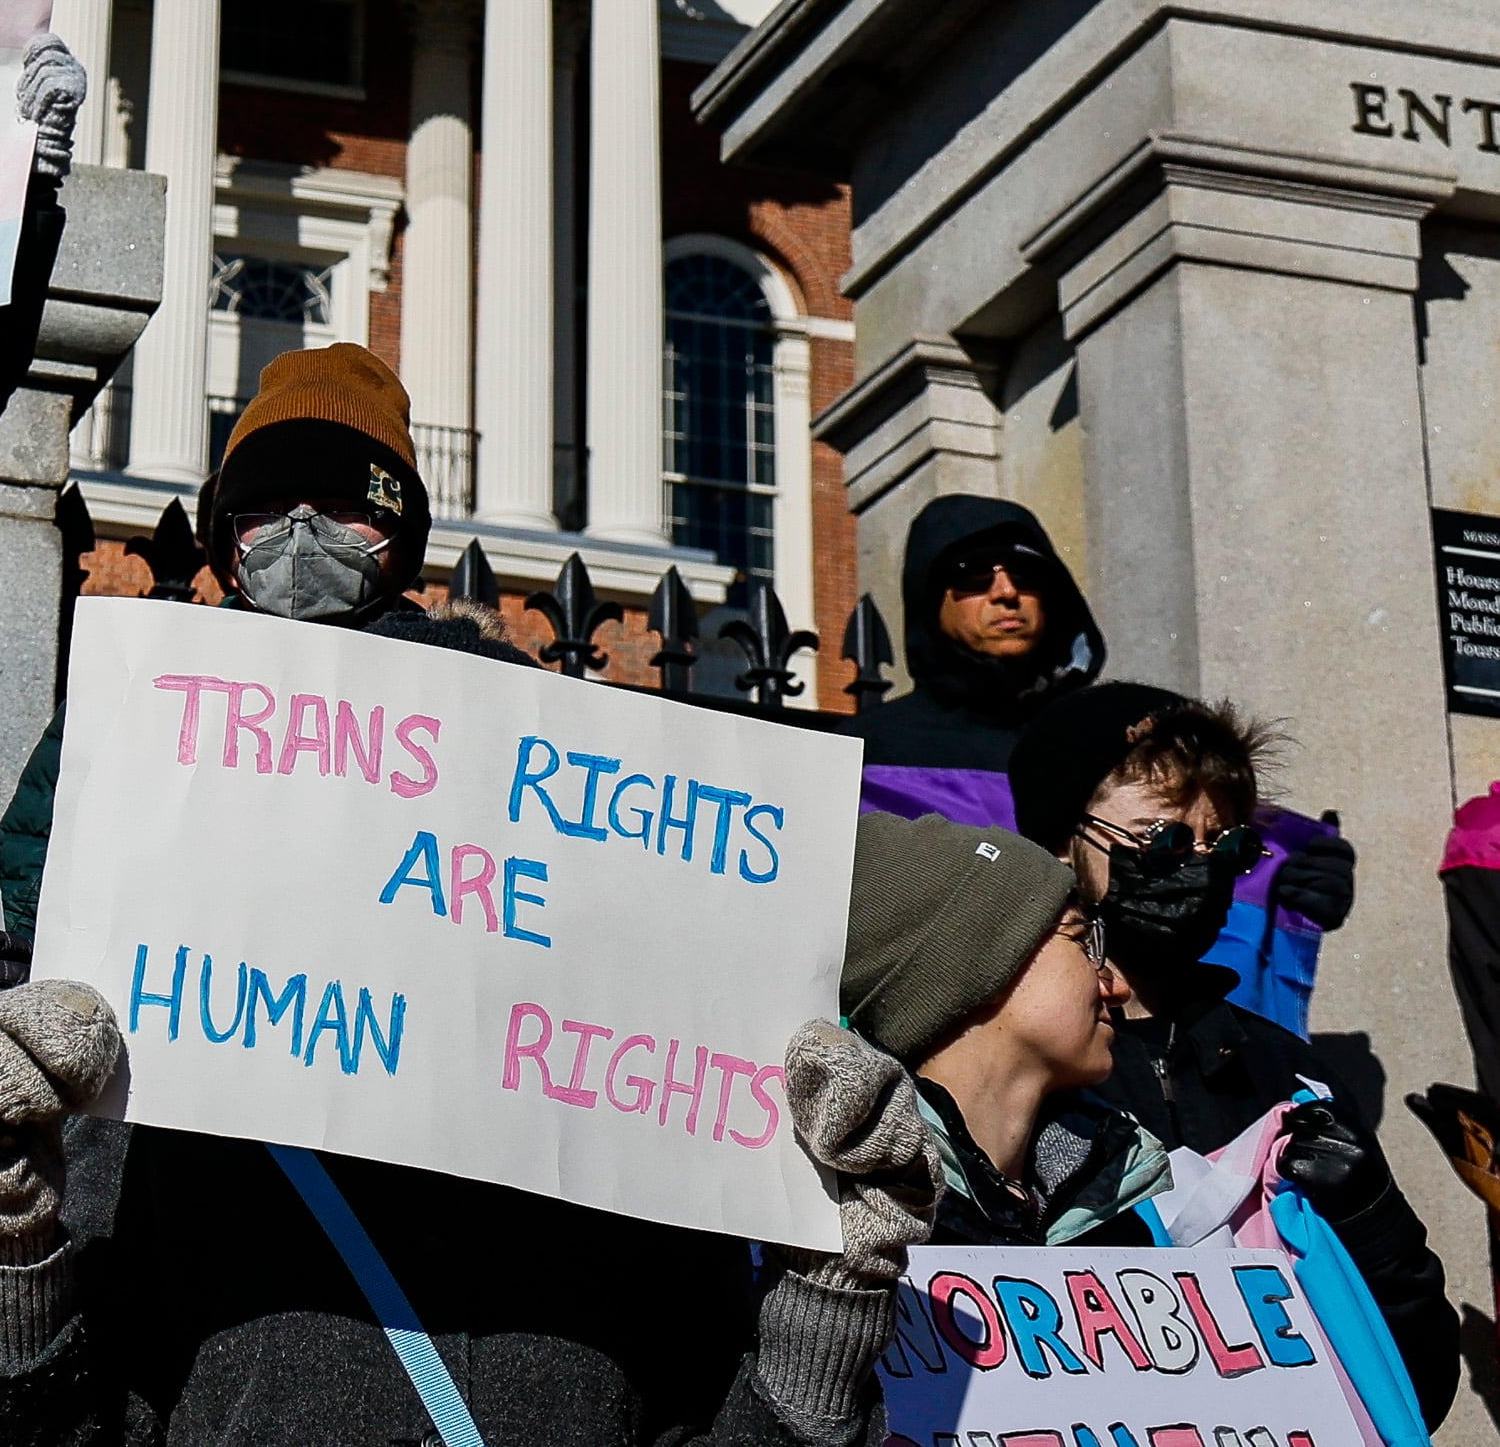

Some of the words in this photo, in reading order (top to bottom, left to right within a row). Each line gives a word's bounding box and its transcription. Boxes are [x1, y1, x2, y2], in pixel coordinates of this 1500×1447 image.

[152, 674, 441, 799] TRANS
[508, 735, 784, 884] RIGHTS
[379, 831, 552, 949] ARE
[129, 944, 406, 1076] HUMAN
[501, 1002, 787, 1149] RIGHTS
